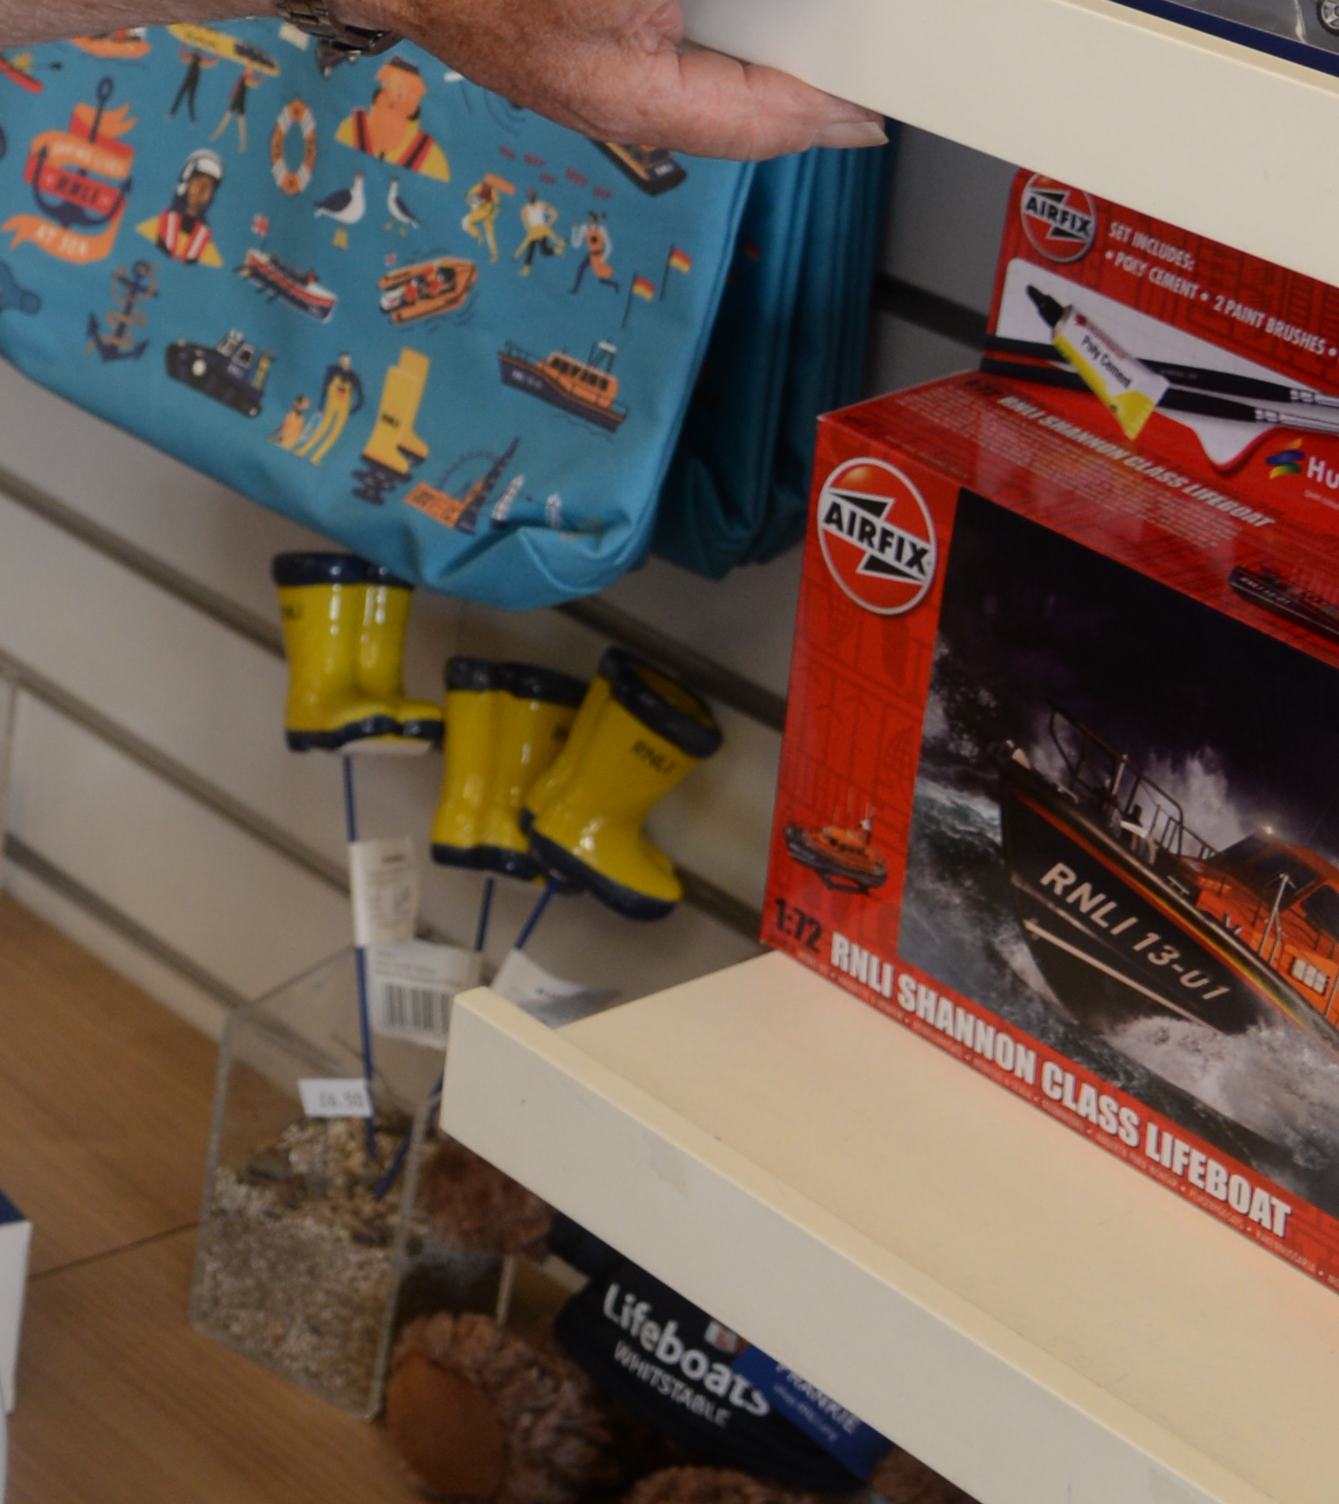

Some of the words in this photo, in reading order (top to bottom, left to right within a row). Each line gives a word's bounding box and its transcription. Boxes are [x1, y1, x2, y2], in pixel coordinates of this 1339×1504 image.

[1025, 195, 1092, 237] AIRFIX
[1108, 220, 1132, 242] SET
[1133, 231, 1197, 271] INCLUDES:
[1114, 250, 1148, 278] POLY
[1148, 264, 1199, 300] CEMENT
[1213, 295, 1224, 312] 2
[1224, 297, 1266, 330] PAINT
[1265, 316, 1327, 356] BRUSHES
[1081, 334, 1103, 362] Poly
[1100, 353, 1133, 389] Cement
[821, 499, 931, 578] AIRFIX
[629, 738, 676, 775] RNLI
[774, 897, 823, 954] 1:72
[1039, 860, 1140, 938] RNLI
[830, 930, 895, 999] RNLI
[896, 972, 1038, 1087] SHANNON
[1041, 1060, 1141, 1149] CLASS
[1145, 1121, 1293, 1239] LIFEBOAT
[602, 1282, 771, 1417] Lifeboats
[613, 1340, 733, 1428] WHITSTABLE
